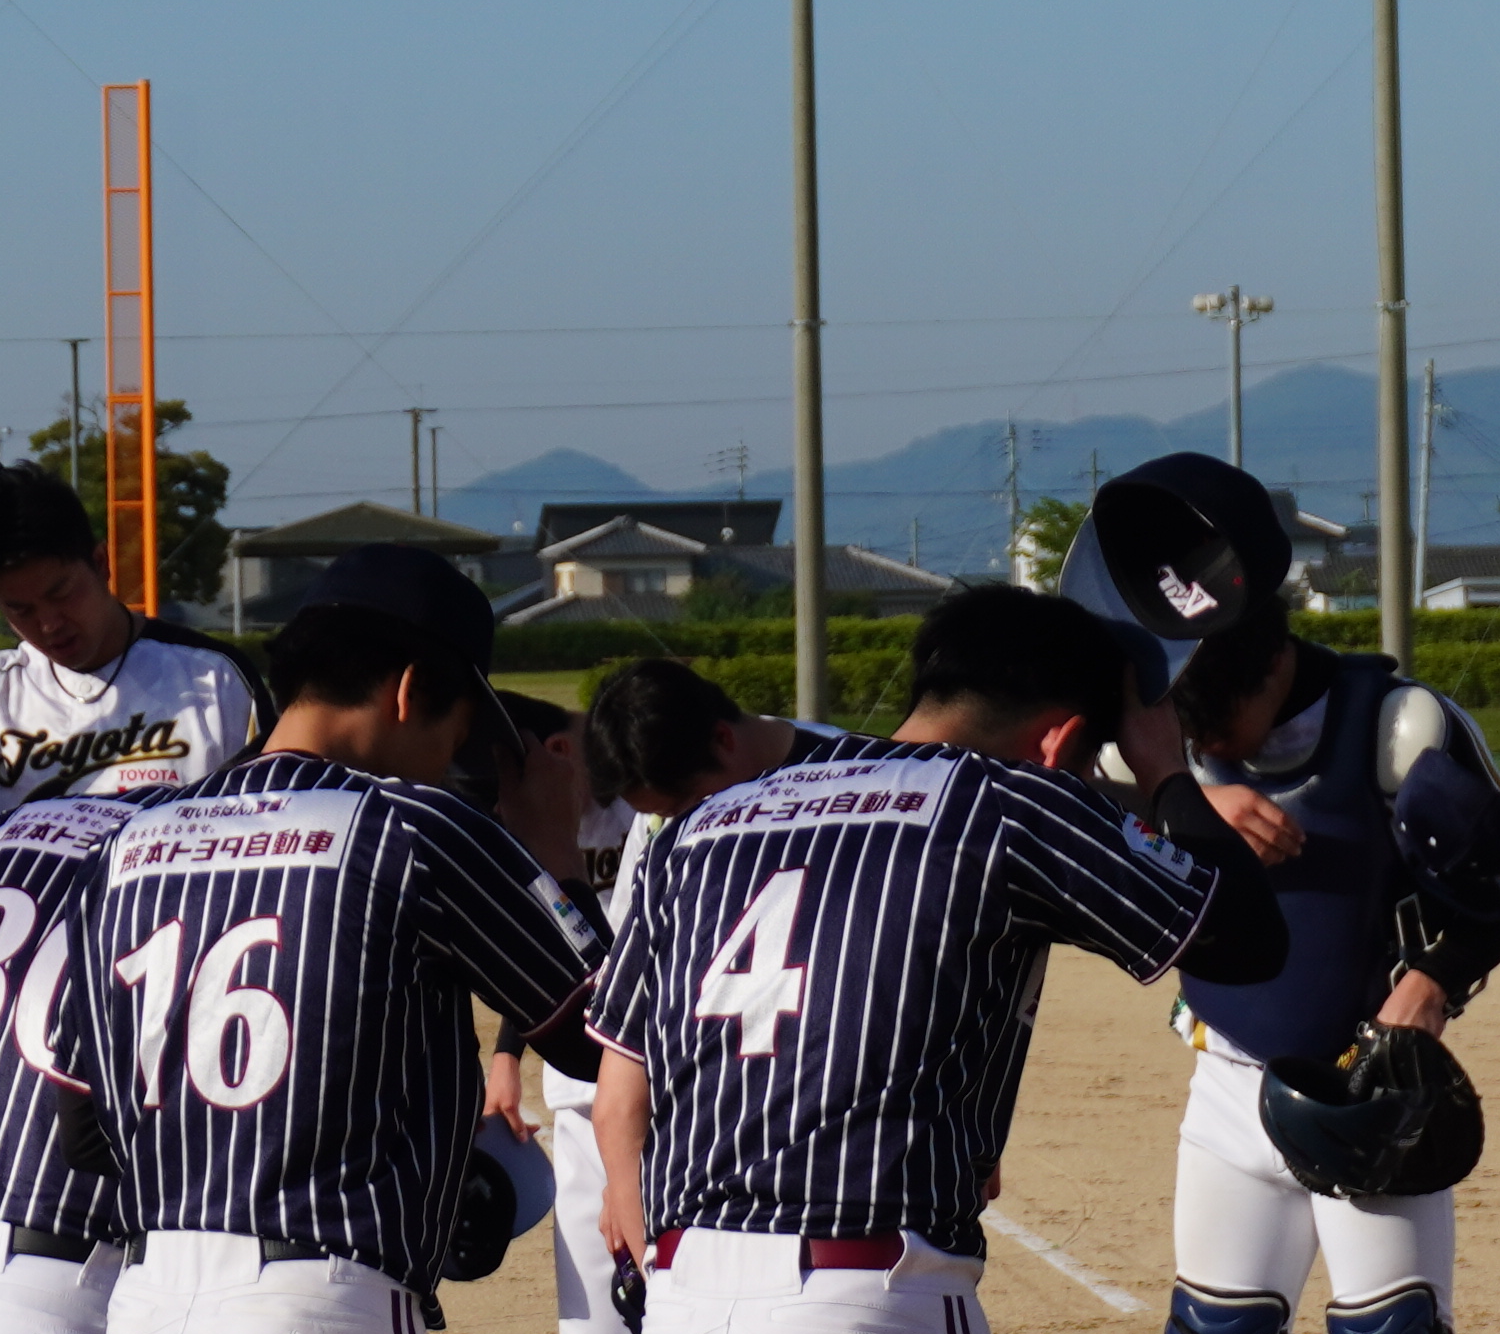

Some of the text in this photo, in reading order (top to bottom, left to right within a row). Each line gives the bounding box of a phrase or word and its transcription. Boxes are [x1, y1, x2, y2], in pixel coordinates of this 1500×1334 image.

[118, 769, 179, 781] TOYOTA
[688, 790, 929, 835] 熊本トヨタ自動車
[120, 828, 336, 873] 熊本トヨタ自動車
[693, 866, 809, 1059] 4
[113, 913, 292, 1111] 16
